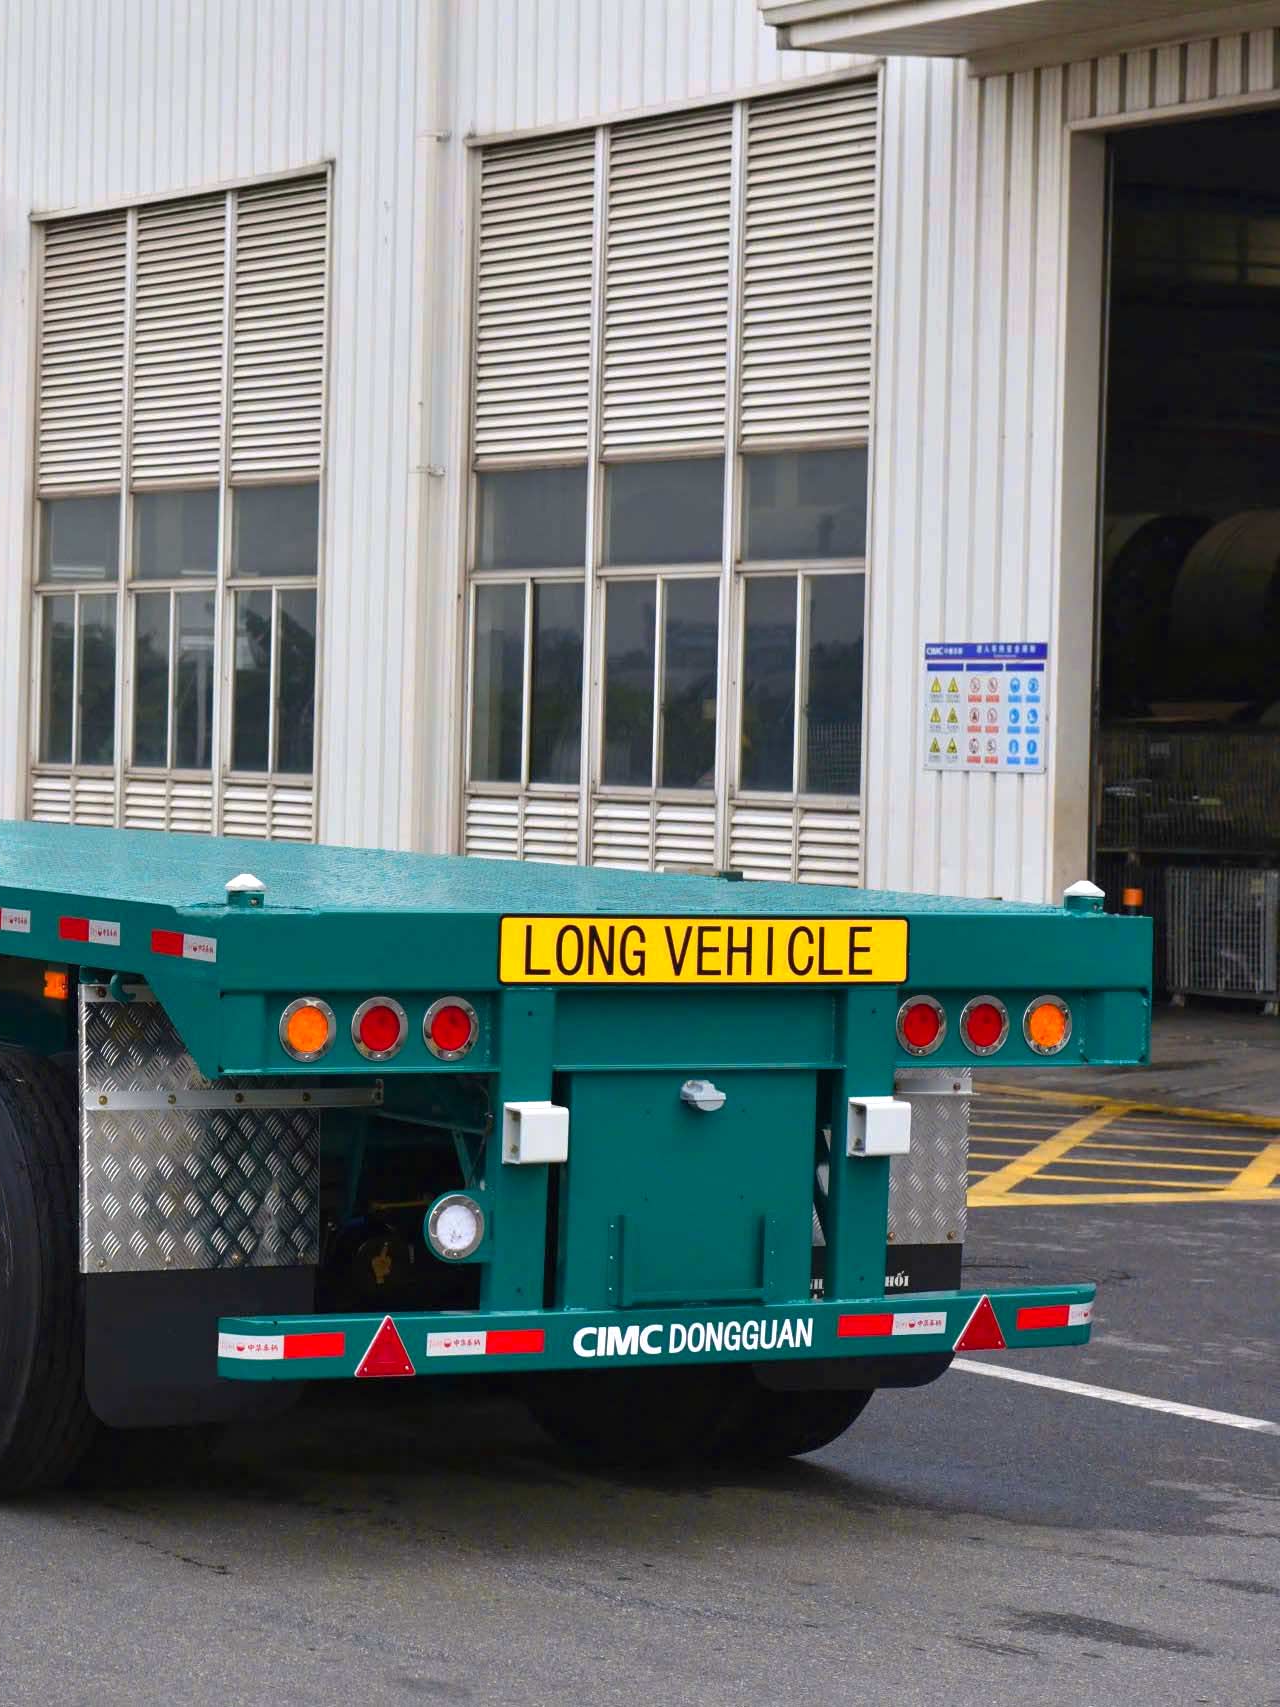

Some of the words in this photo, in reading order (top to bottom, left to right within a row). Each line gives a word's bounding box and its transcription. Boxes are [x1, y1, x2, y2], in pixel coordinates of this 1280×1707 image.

[524, 924, 647, 977] LONG
[663, 925, 874, 977] VEHICLE
[884, 1270, 910, 1288] HỐI
[572, 1324, 664, 1358] CIMC
[668, 1317, 814, 1354] DONGGUAN
